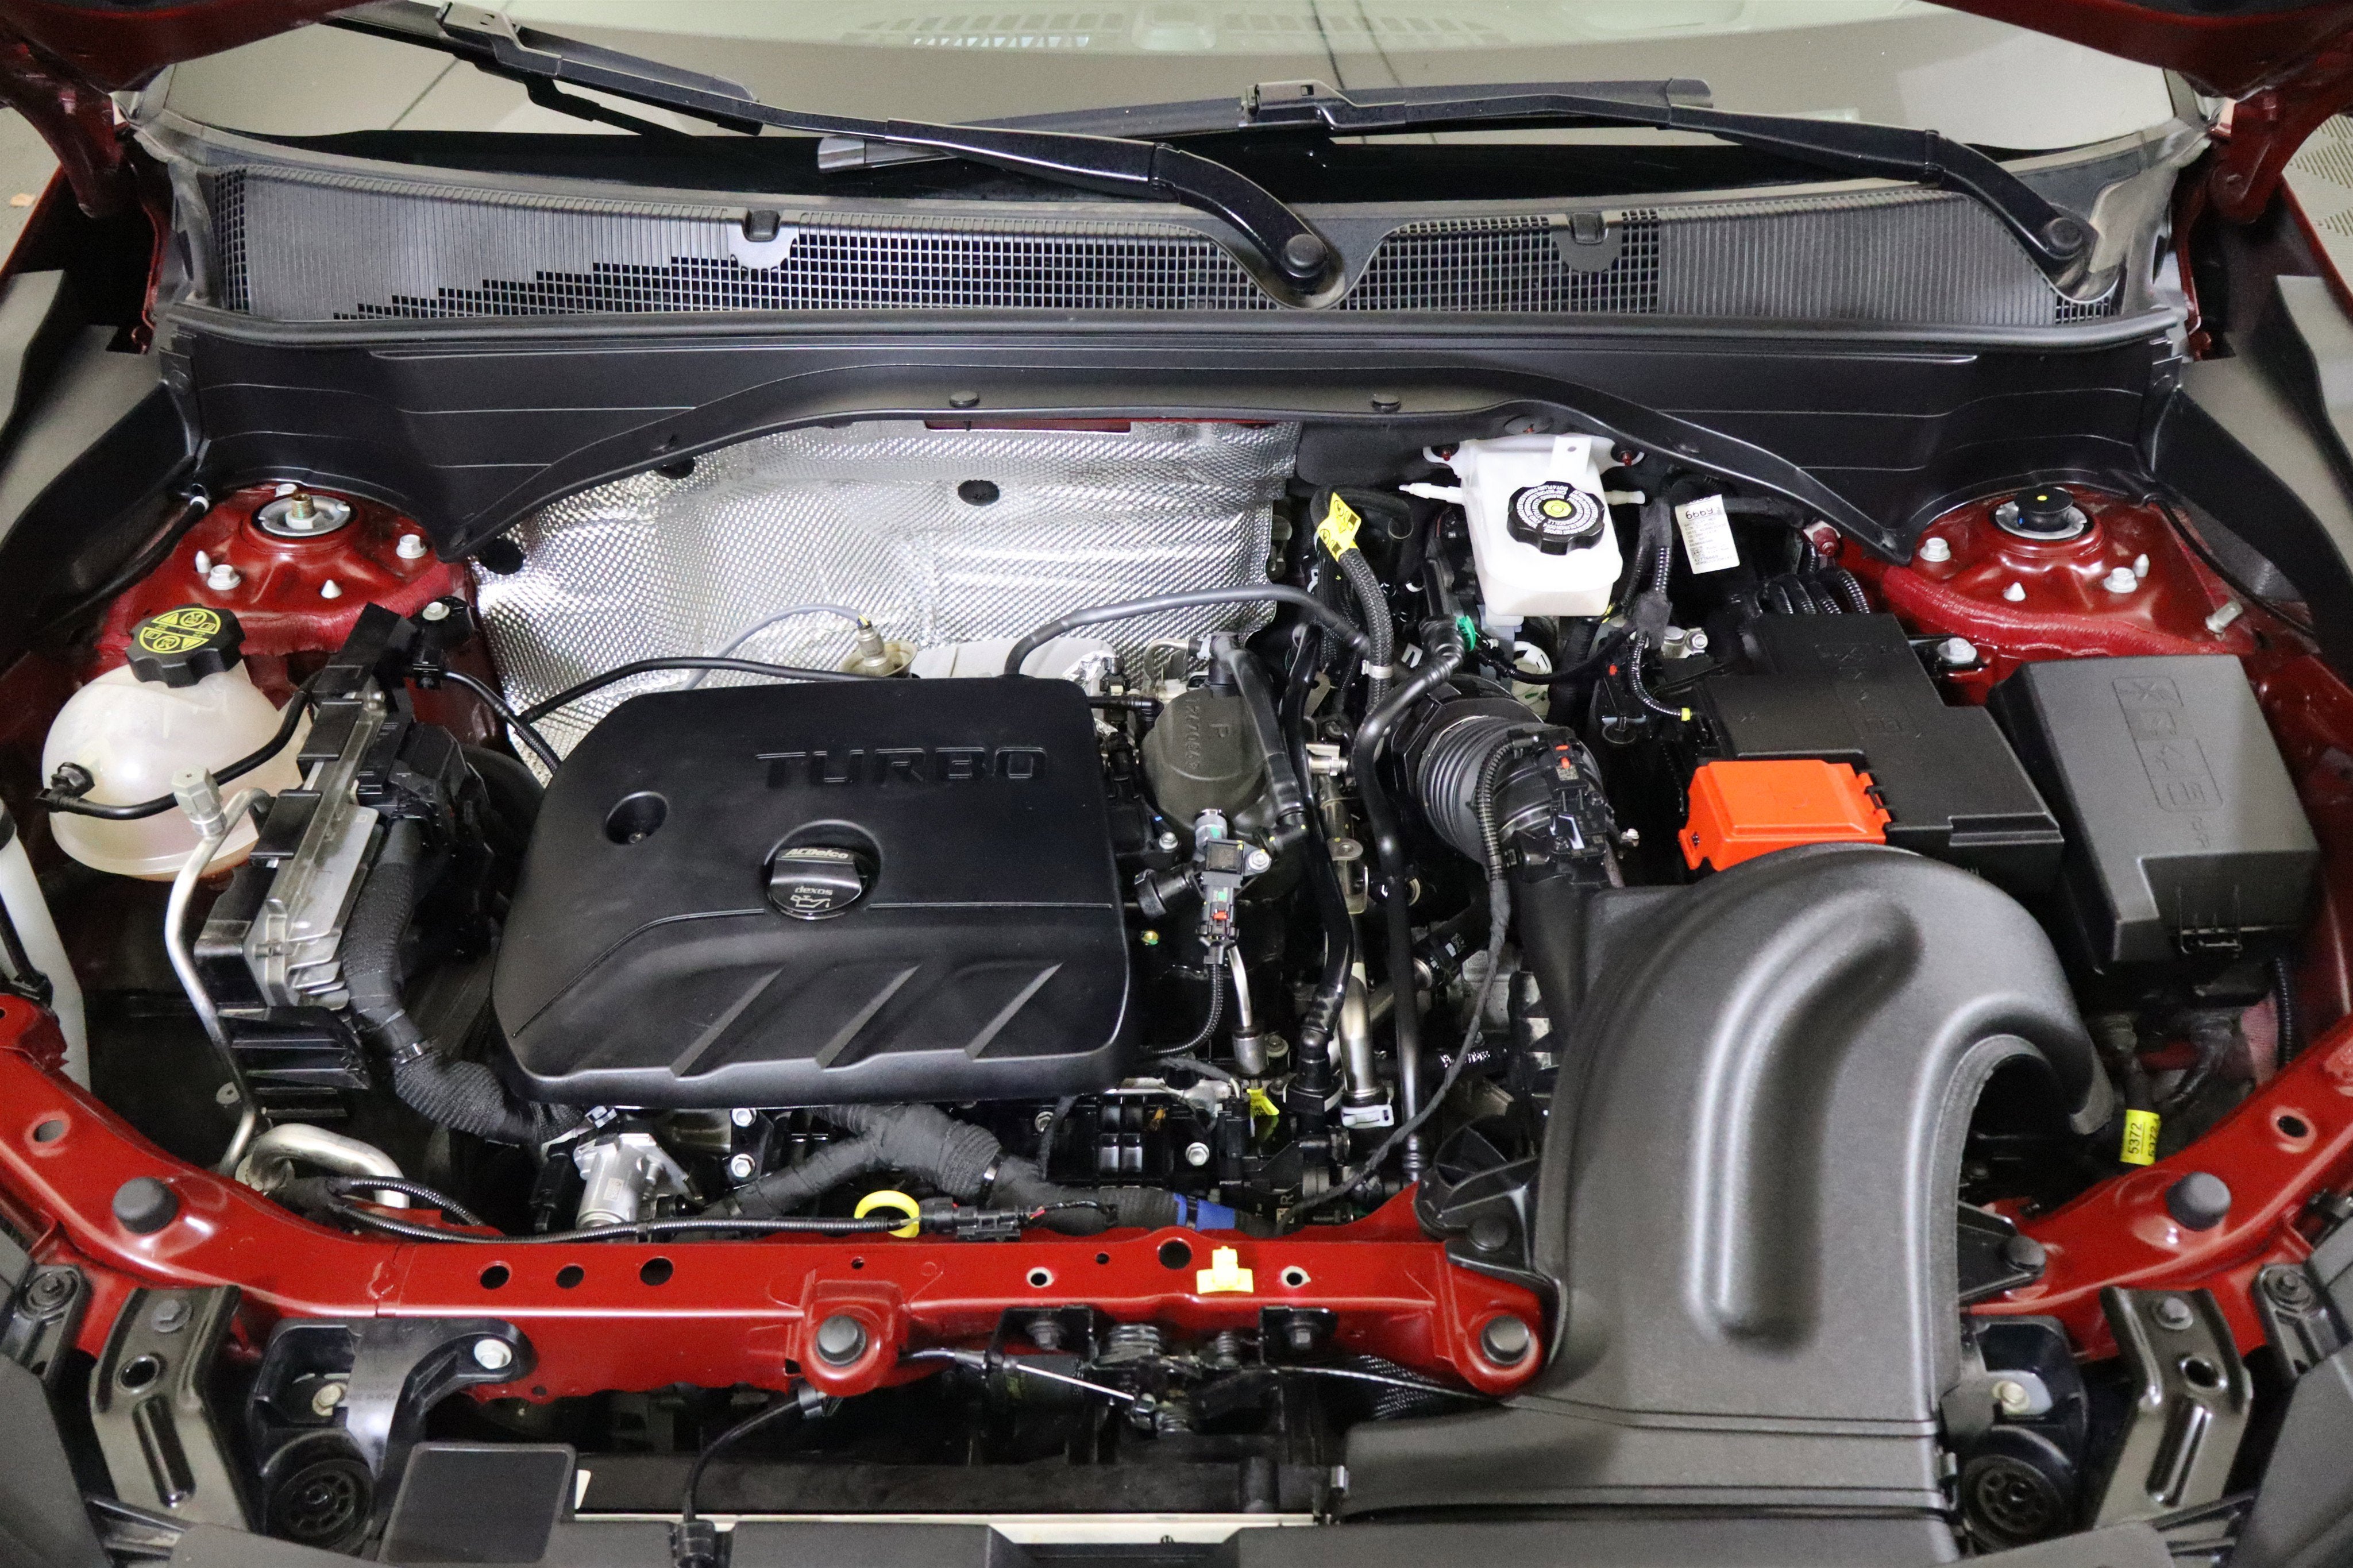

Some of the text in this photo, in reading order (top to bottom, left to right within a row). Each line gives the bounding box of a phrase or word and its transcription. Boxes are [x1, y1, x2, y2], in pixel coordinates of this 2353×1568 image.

[755, 747, 1047, 787] TURBO
[782, 847, 848, 859] ACDelco
[794, 886, 834, 895] dexos
[2128, 1122, 2143, 1154] 5372
